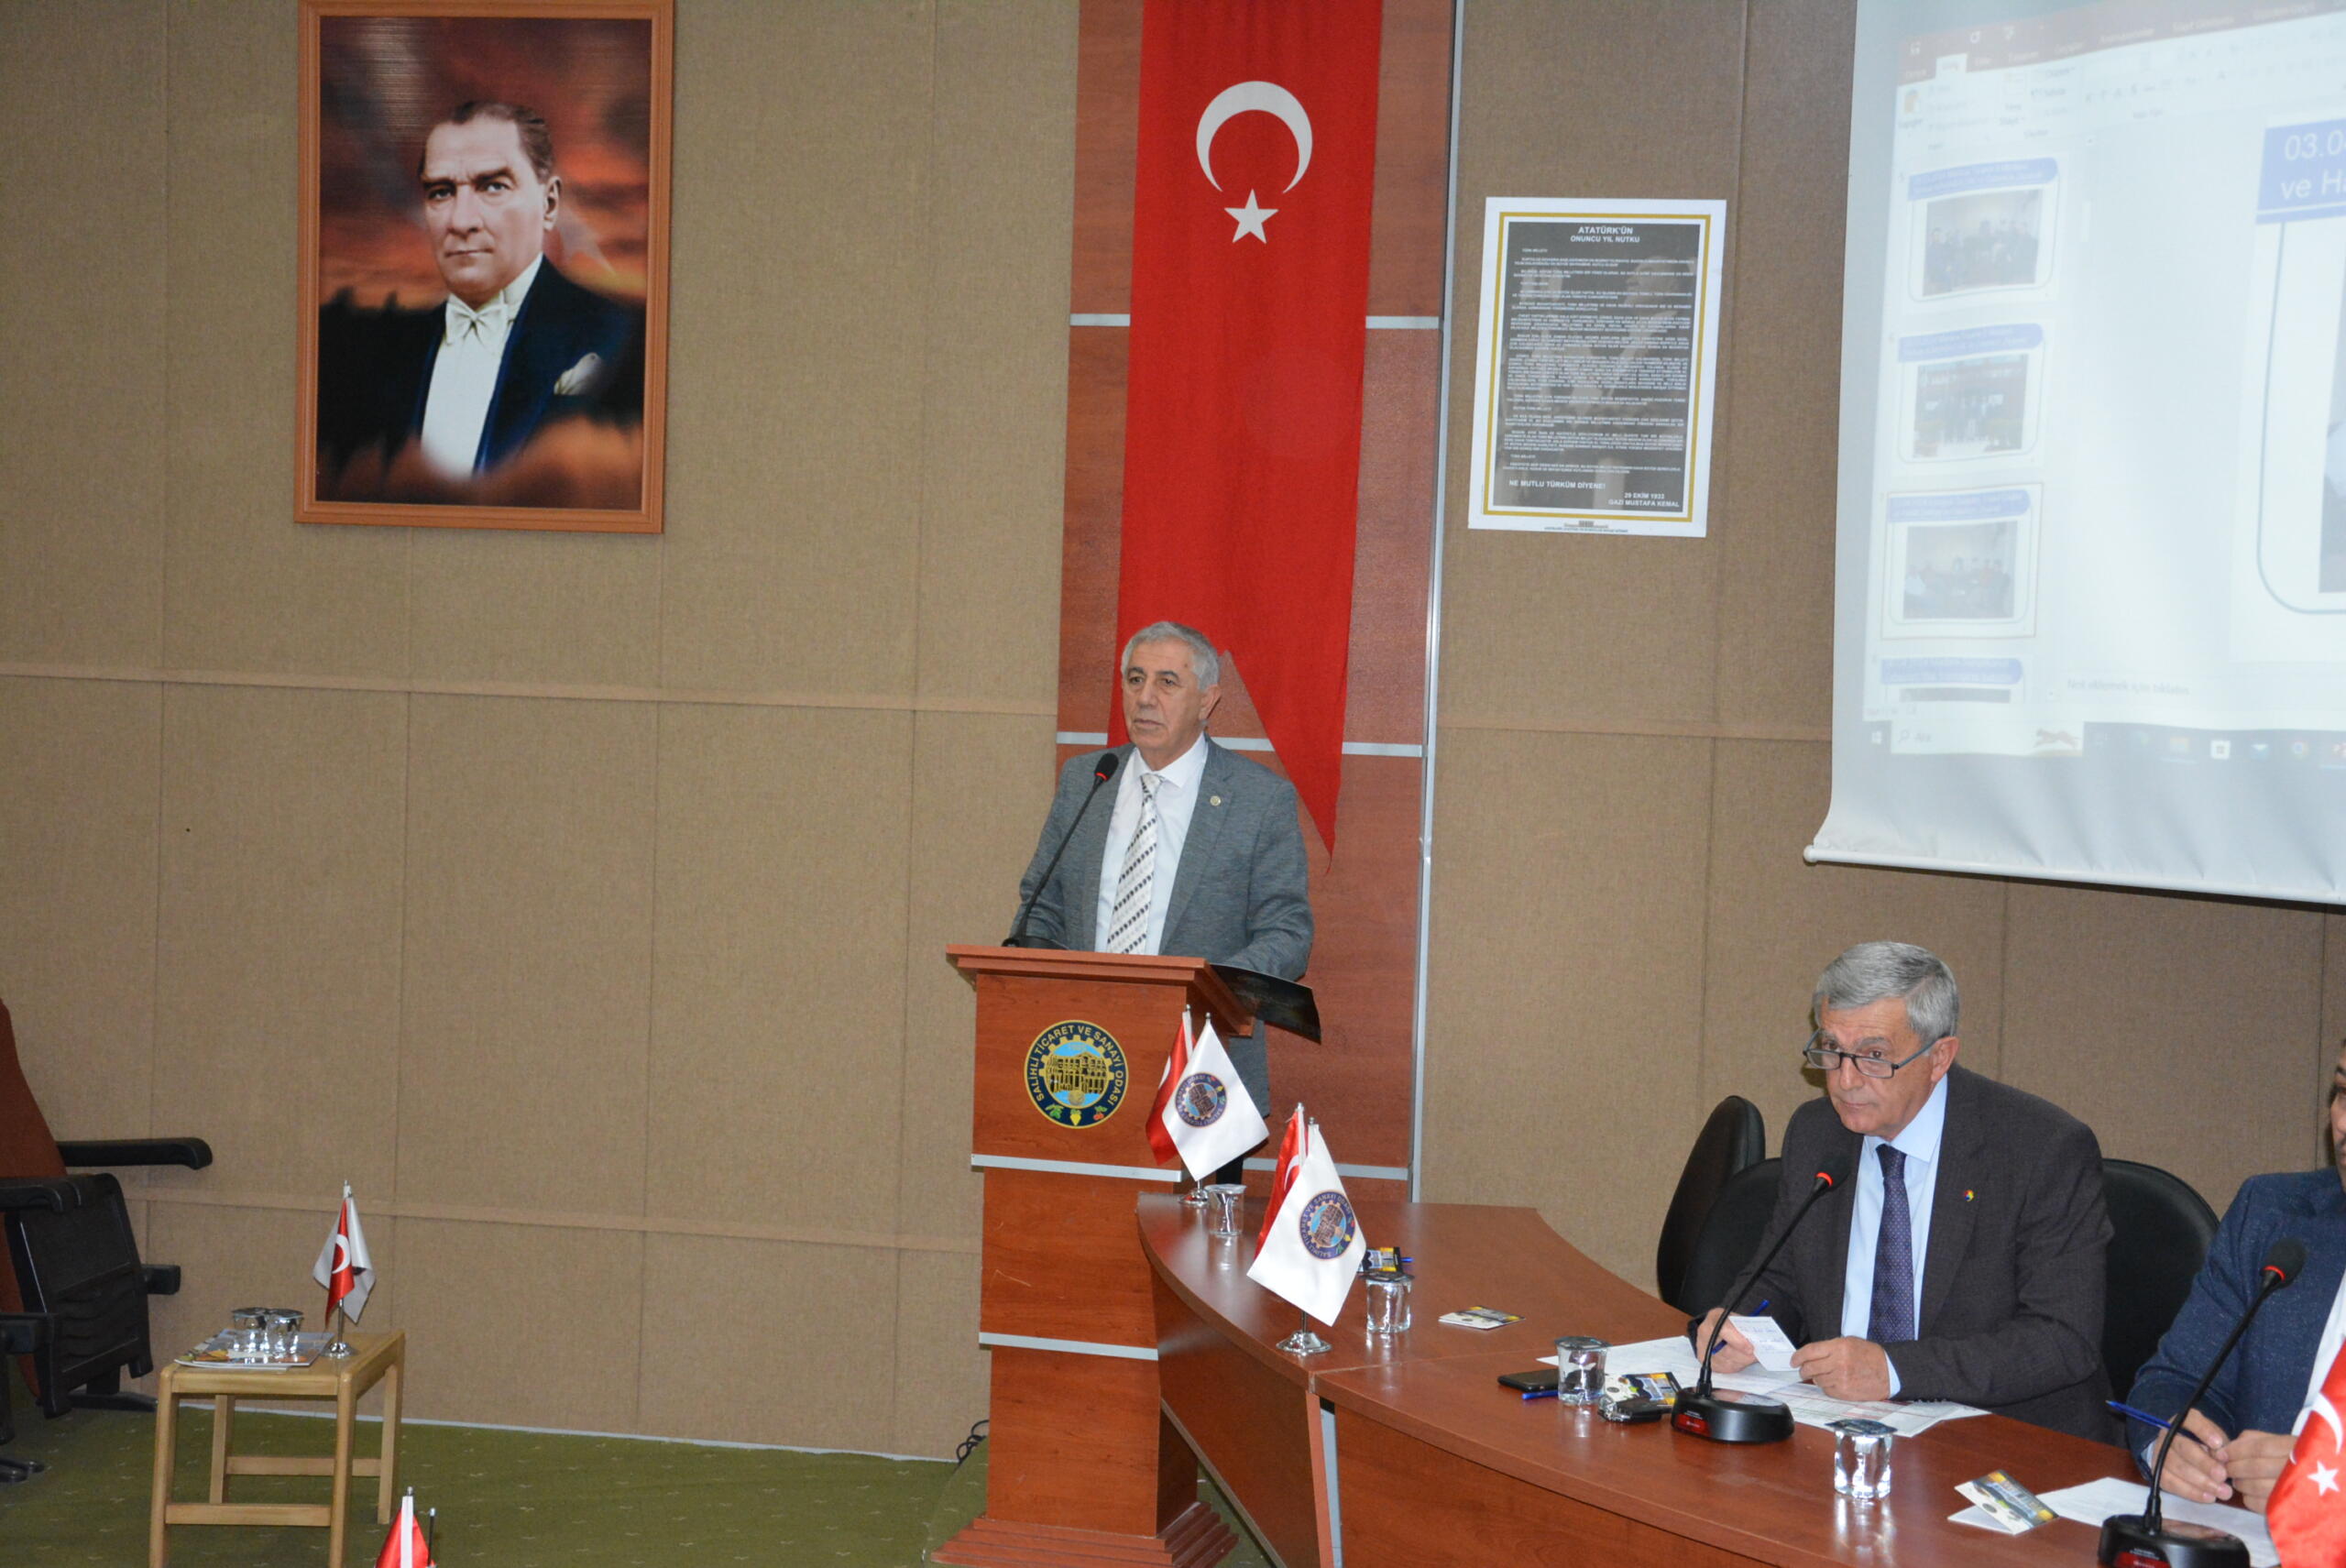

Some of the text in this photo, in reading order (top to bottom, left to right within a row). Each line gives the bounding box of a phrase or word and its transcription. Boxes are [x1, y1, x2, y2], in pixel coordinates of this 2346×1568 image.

[2284, 129, 2346, 161] 03.0
[2280, 169, 2346, 201] ve H
[1577, 225, 1633, 235] ATATÜRK'ÜN
[1570, 235, 1601, 244] ONUNCU
[1616, 236, 1640, 244] NUTKU
[1520, 480, 1545, 488] MUTLU
[1546, 480, 1576, 488] TÜRKÜM
[1625, 499, 1655, 508] MUSTAFA
[1657, 499, 1680, 509] KEMAL
[1078, 1025, 1091, 1036] VE
[1107, 1070, 1124, 1105] ODASI
